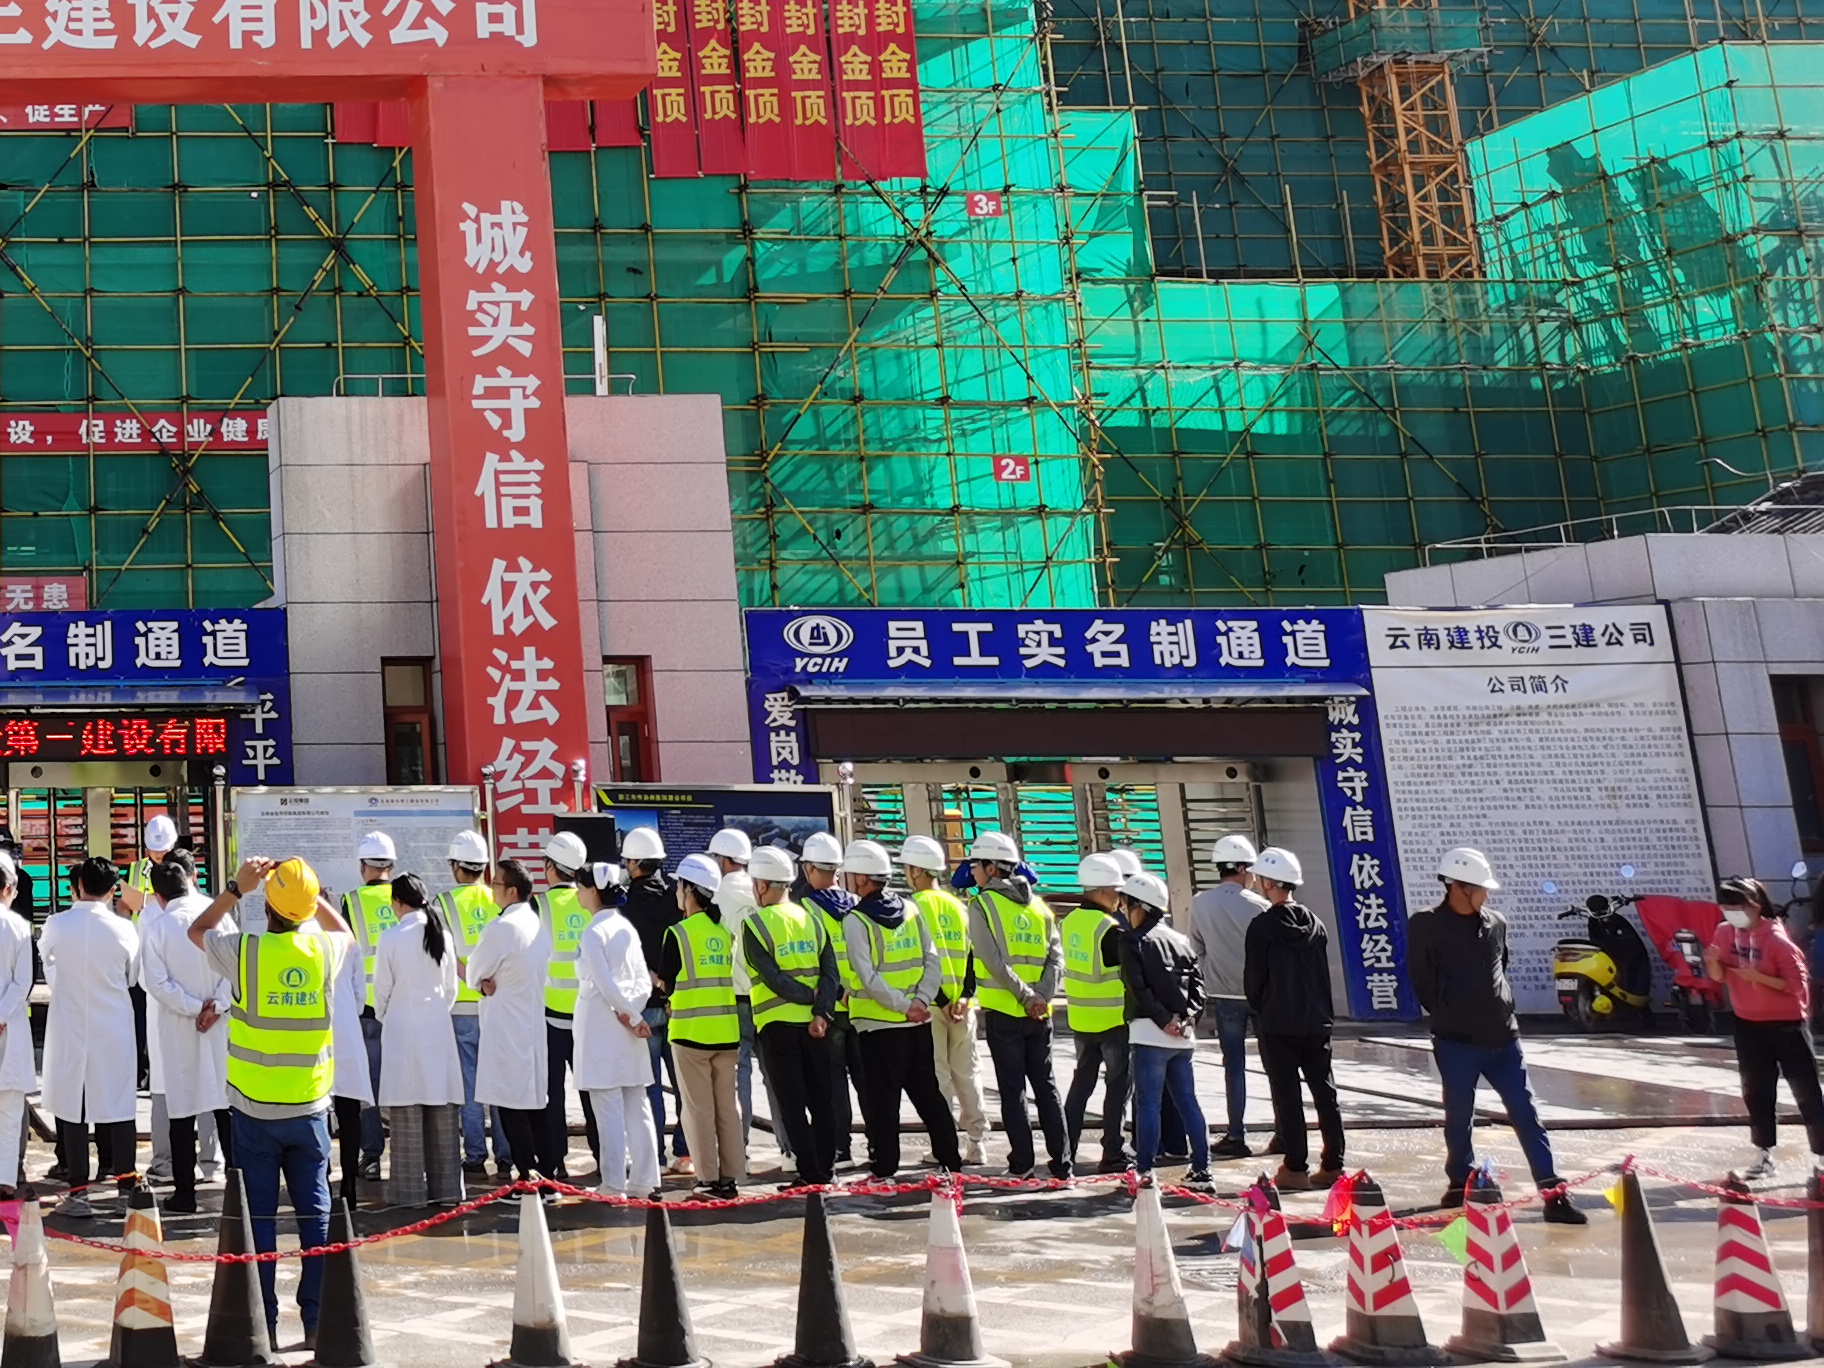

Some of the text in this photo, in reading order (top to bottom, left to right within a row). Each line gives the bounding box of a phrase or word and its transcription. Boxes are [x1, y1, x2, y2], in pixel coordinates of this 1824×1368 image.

[973, 194, 997, 215] 3F
[459, 200, 545, 530] 诚实守信
[1005, 458, 1030, 480] 2F
[886, 618, 1333, 670] 员工实名制通道
[1384, 621, 1656, 651] 云南建投 三建公司
[1510, 645, 1540, 654] YCIH
[794, 657, 849, 674] YCIH
[1487, 673, 1570, 695] 公司简介
[1326, 696, 1400, 1012] 诚实守信 依法经营
[266, 991, 319, 1007] 云南建投
